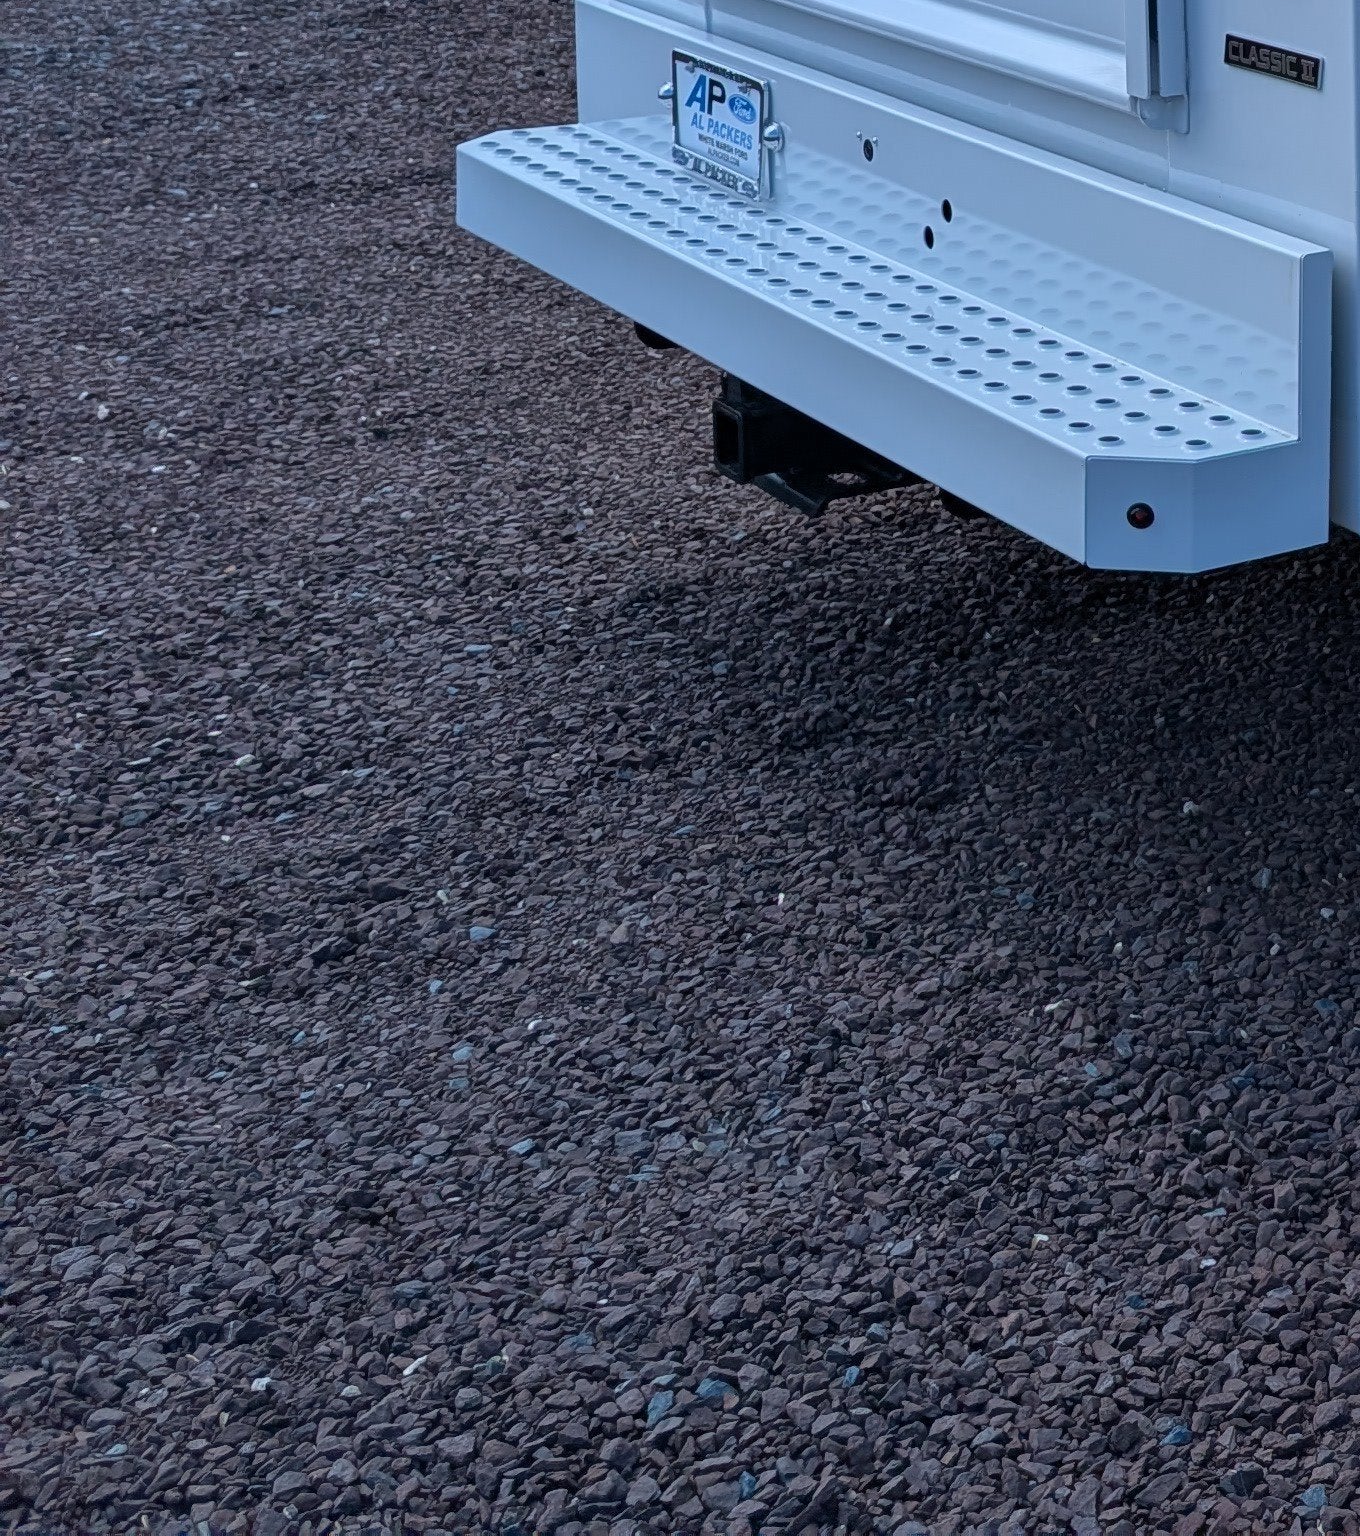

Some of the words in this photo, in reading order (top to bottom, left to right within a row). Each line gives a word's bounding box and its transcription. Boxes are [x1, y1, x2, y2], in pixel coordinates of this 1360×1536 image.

[1228, 40, 1298, 78] CLASSIC
[684, 73, 726, 116] AP
[690, 112, 705, 131] AL
[707, 117, 753, 151] PACKERS
